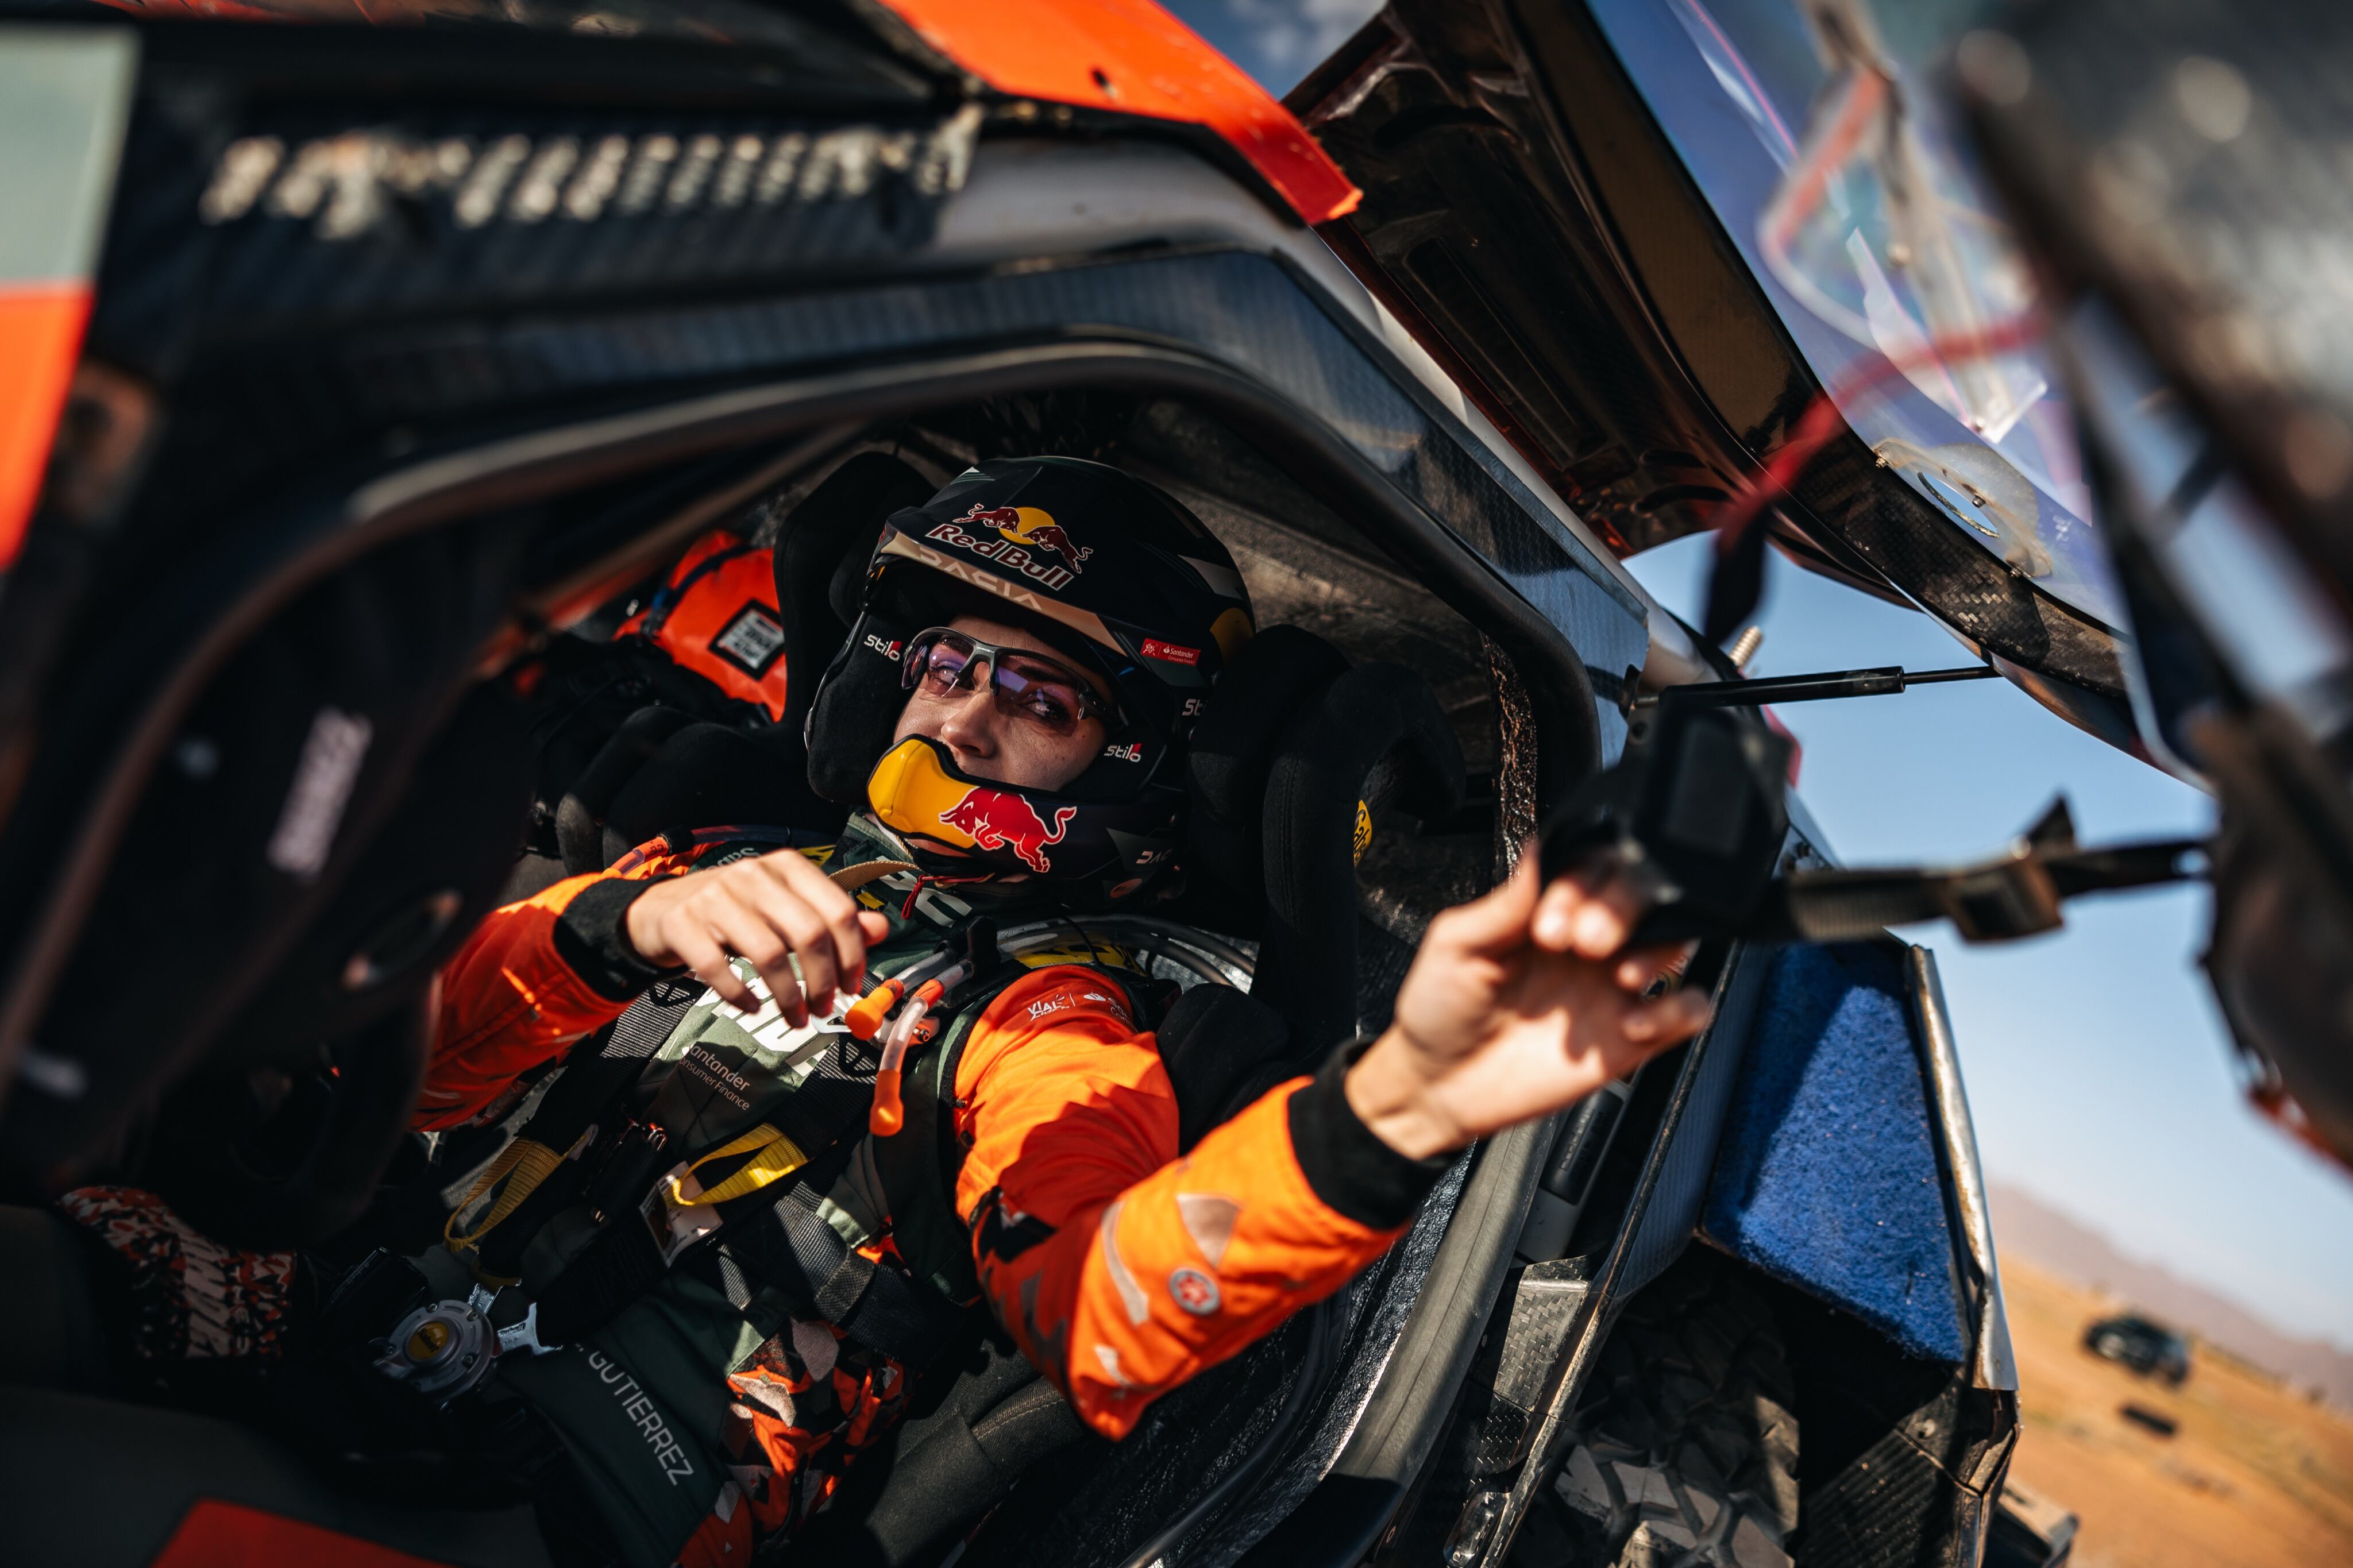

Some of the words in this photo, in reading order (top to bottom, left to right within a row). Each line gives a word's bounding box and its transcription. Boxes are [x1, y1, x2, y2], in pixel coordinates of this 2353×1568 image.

[919, 546, 1042, 611] DACIA
[1170, 648, 1194, 658] Santander
[679, 1057, 718, 1090] onsumer
[717, 1081, 750, 1111] Finance
[690, 1045, 751, 1091] antander
[589, 1351, 694, 1486] GUTIERREZ
